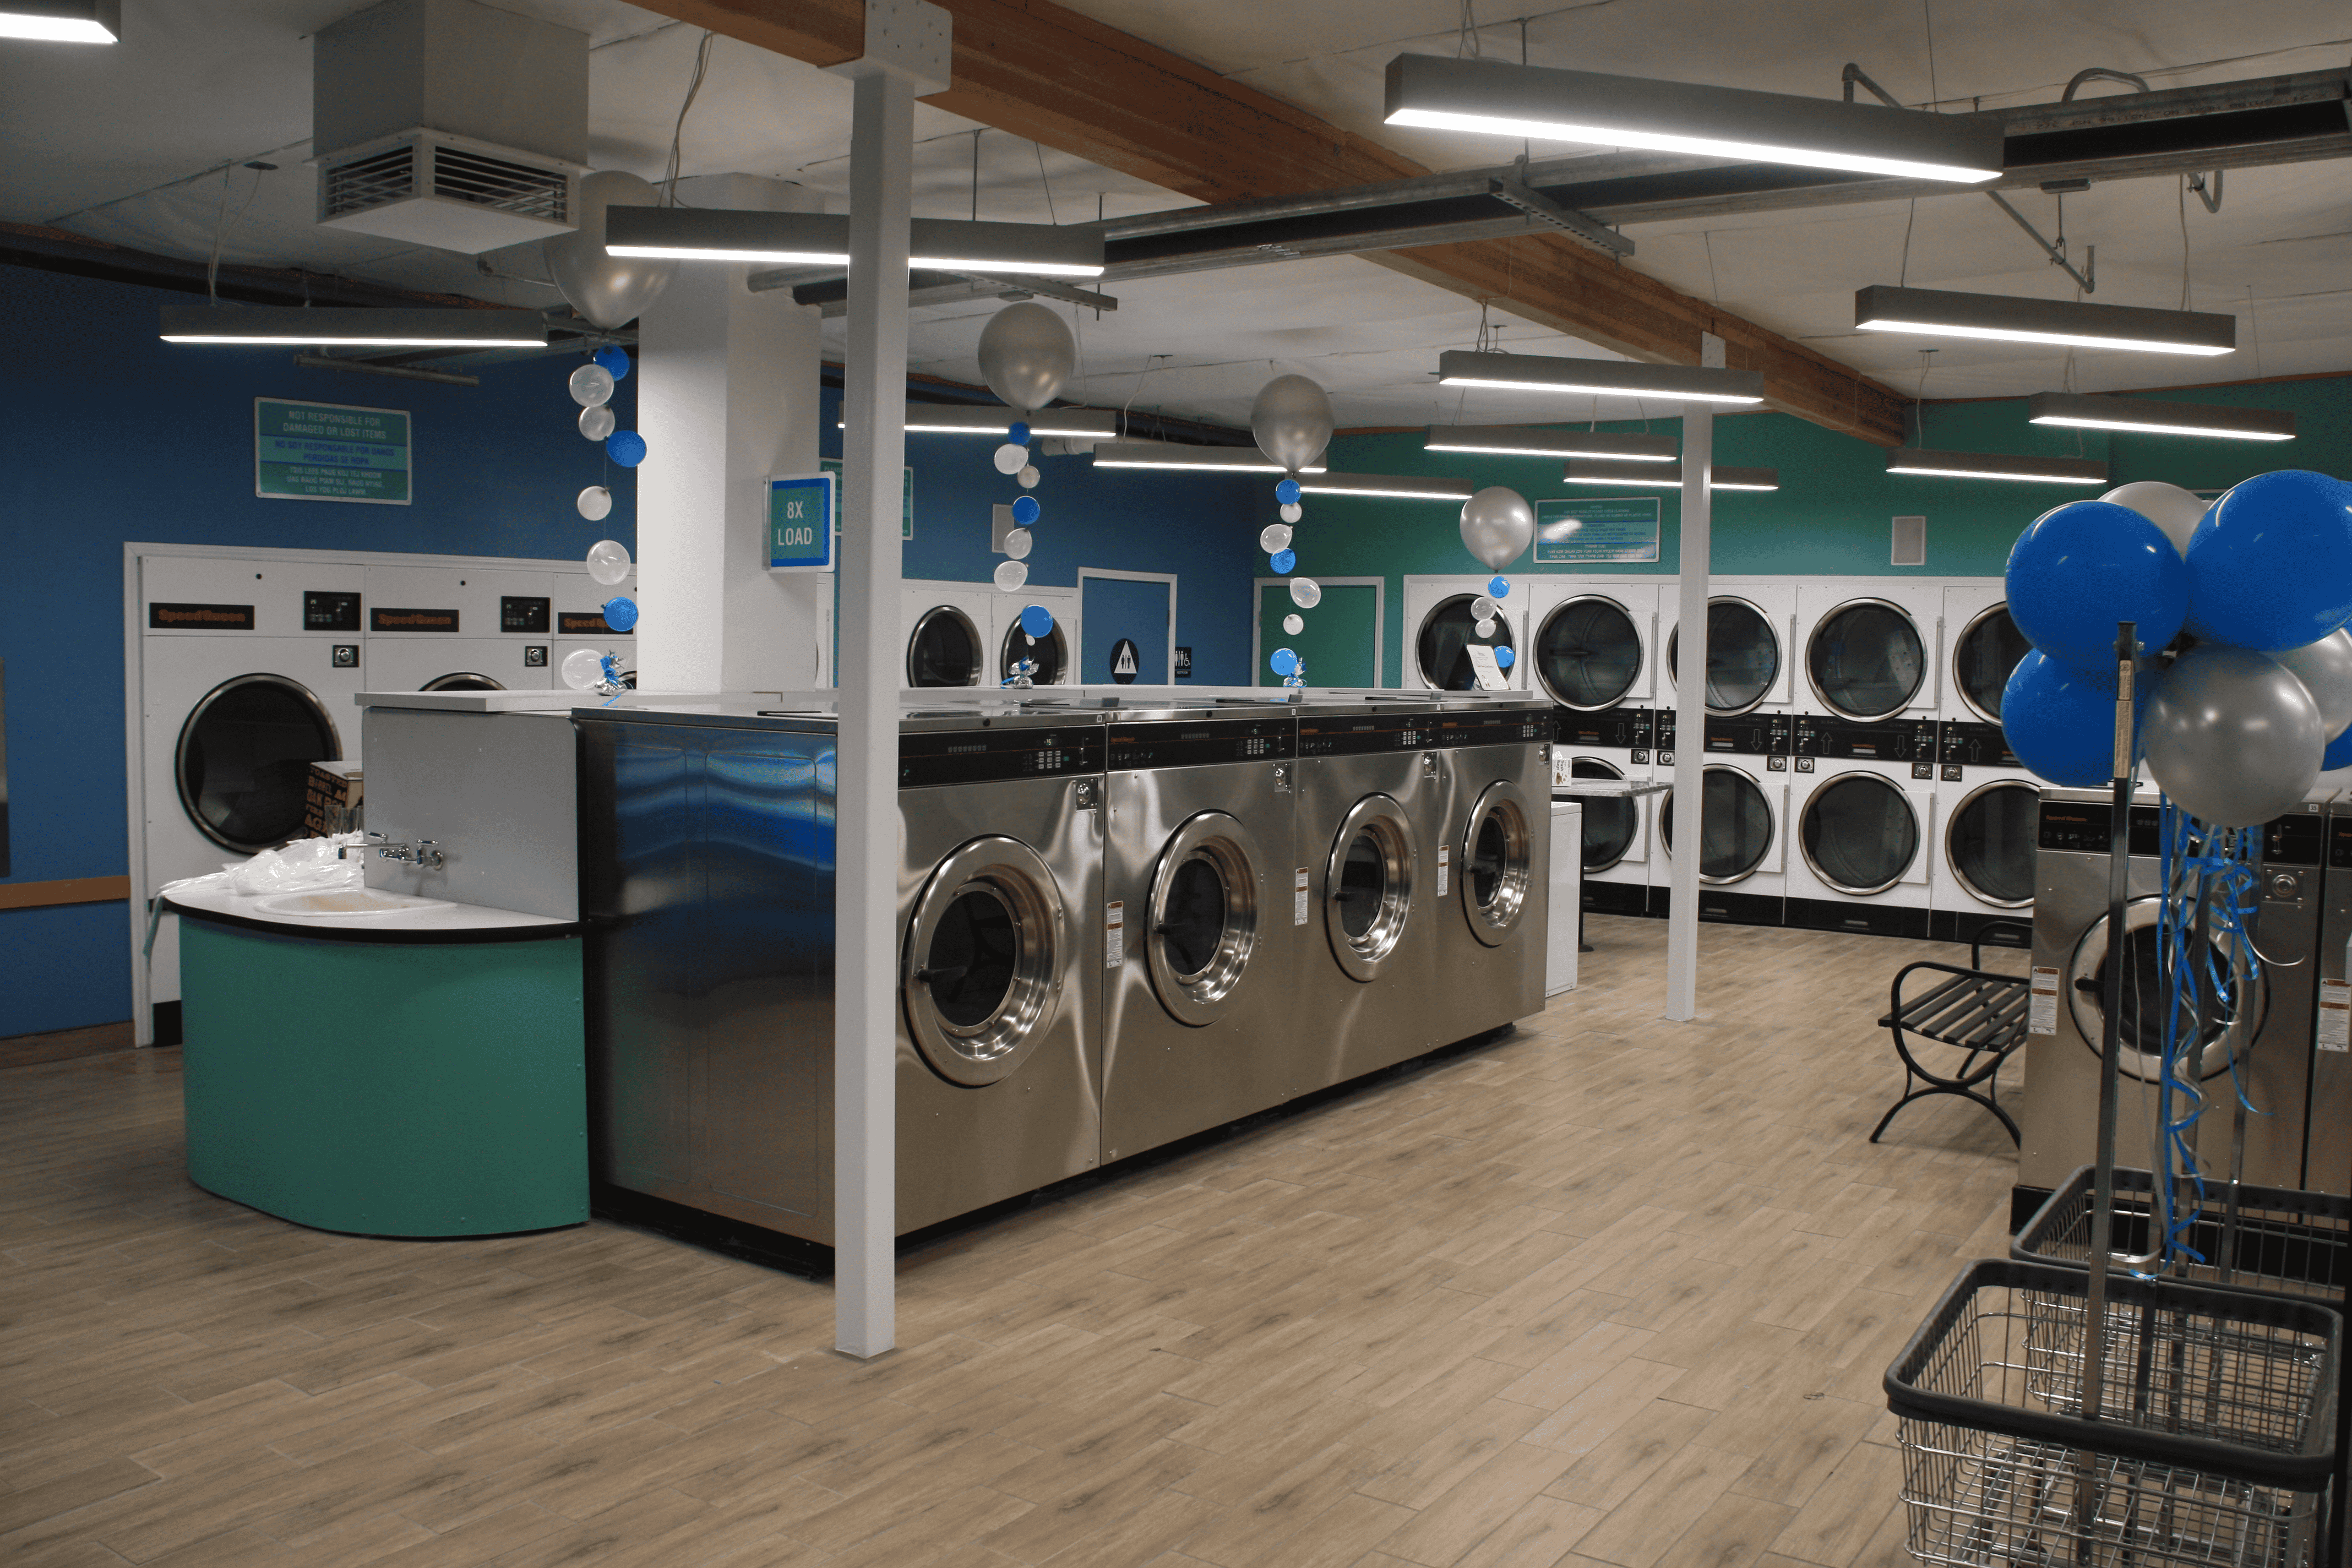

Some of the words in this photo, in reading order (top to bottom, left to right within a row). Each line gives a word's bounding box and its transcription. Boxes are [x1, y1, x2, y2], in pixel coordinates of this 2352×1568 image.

[289, 411, 304, 420] NOT
[308, 413, 363, 425] RESPONSIBLE
[365, 417, 380, 426] FOR
[283, 423, 324, 434] DAMAGED
[326, 426, 338, 435] OR
[341, 428, 360, 437] LOST
[363, 431, 386, 439] ITEMS
[304, 443, 353, 453] RESPONSABLE
[303, 454, 338, 462] PERDIDAS
[351, 456, 369, 465] ROPA
[787, 501, 803, 519] 8X
[777, 527, 813, 546] LOAD
